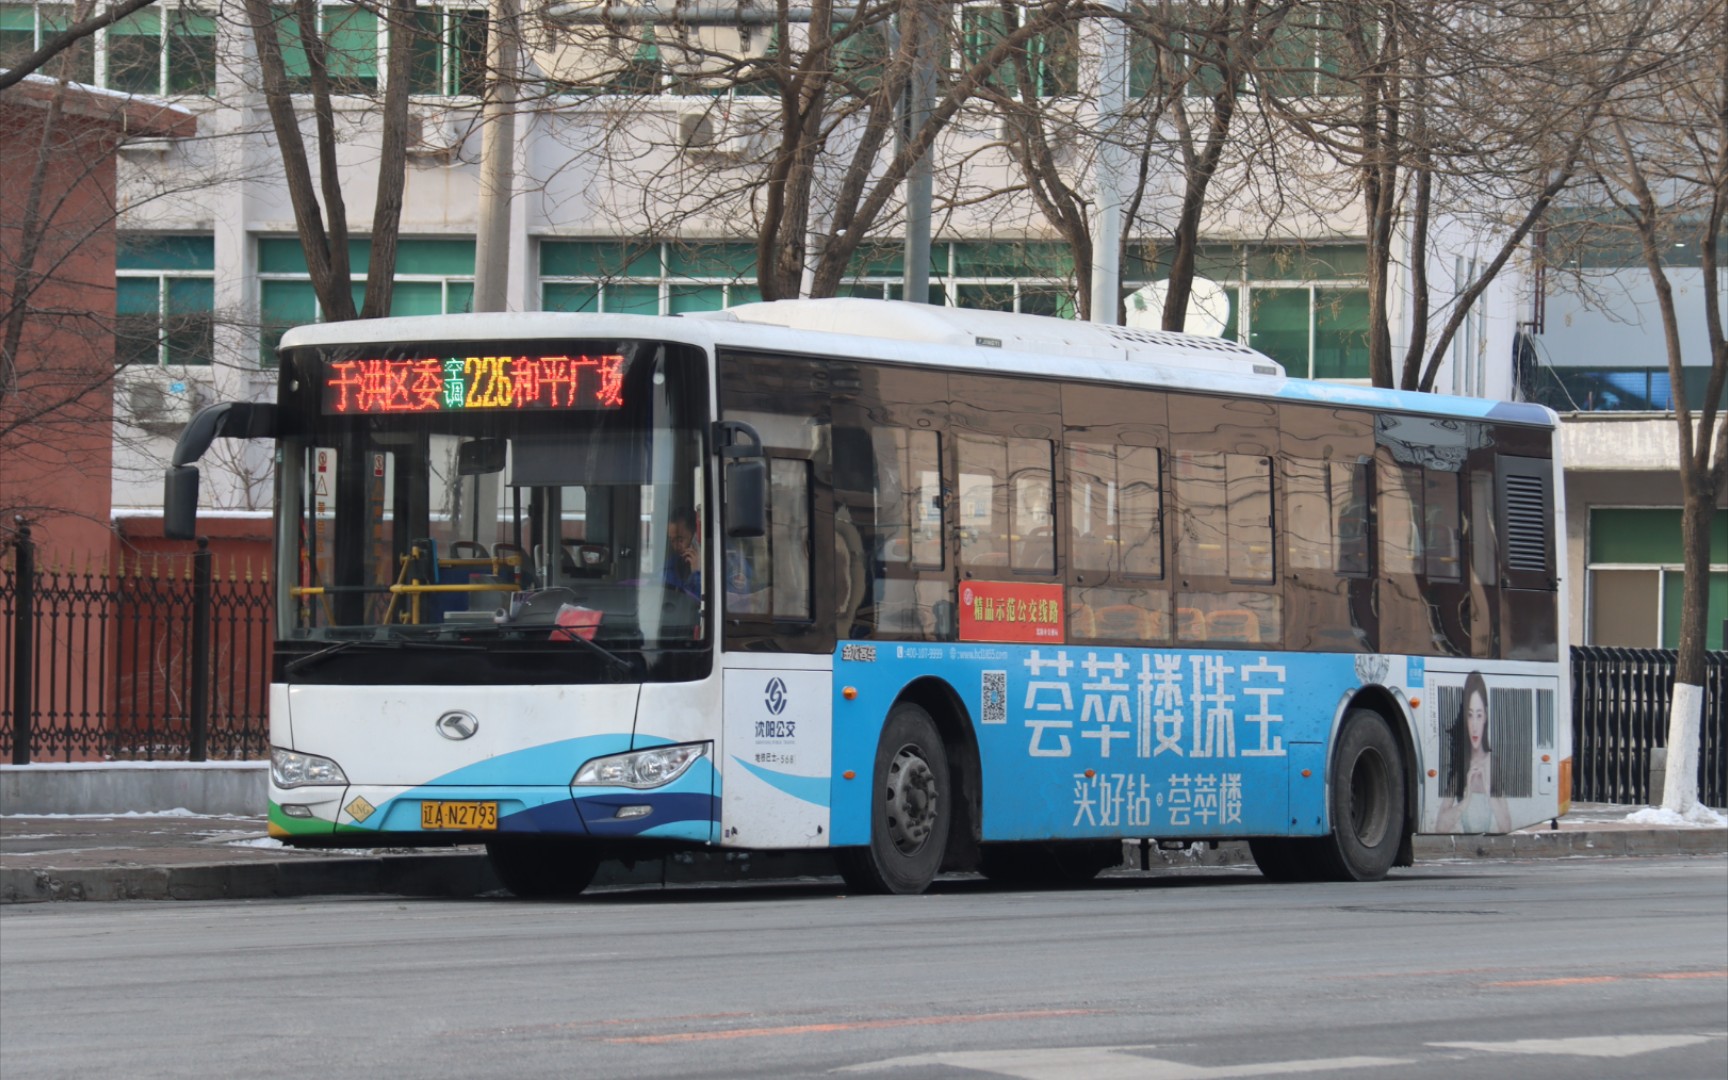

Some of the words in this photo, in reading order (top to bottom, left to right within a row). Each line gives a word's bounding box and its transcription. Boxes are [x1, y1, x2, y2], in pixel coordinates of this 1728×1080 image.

[328, 358, 443, 412] 于洪区委
[443, 357, 465, 408] 空调
[464, 356, 512, 408] 226
[510, 355, 625, 408] 和平广场
[973, 595, 1059, 624] 精品示范公交线路
[1023, 649, 1288, 759] 荟萃楼珠宝
[754, 720, 796, 738] 沈阳公交
[351, 804, 370, 816] LNG
